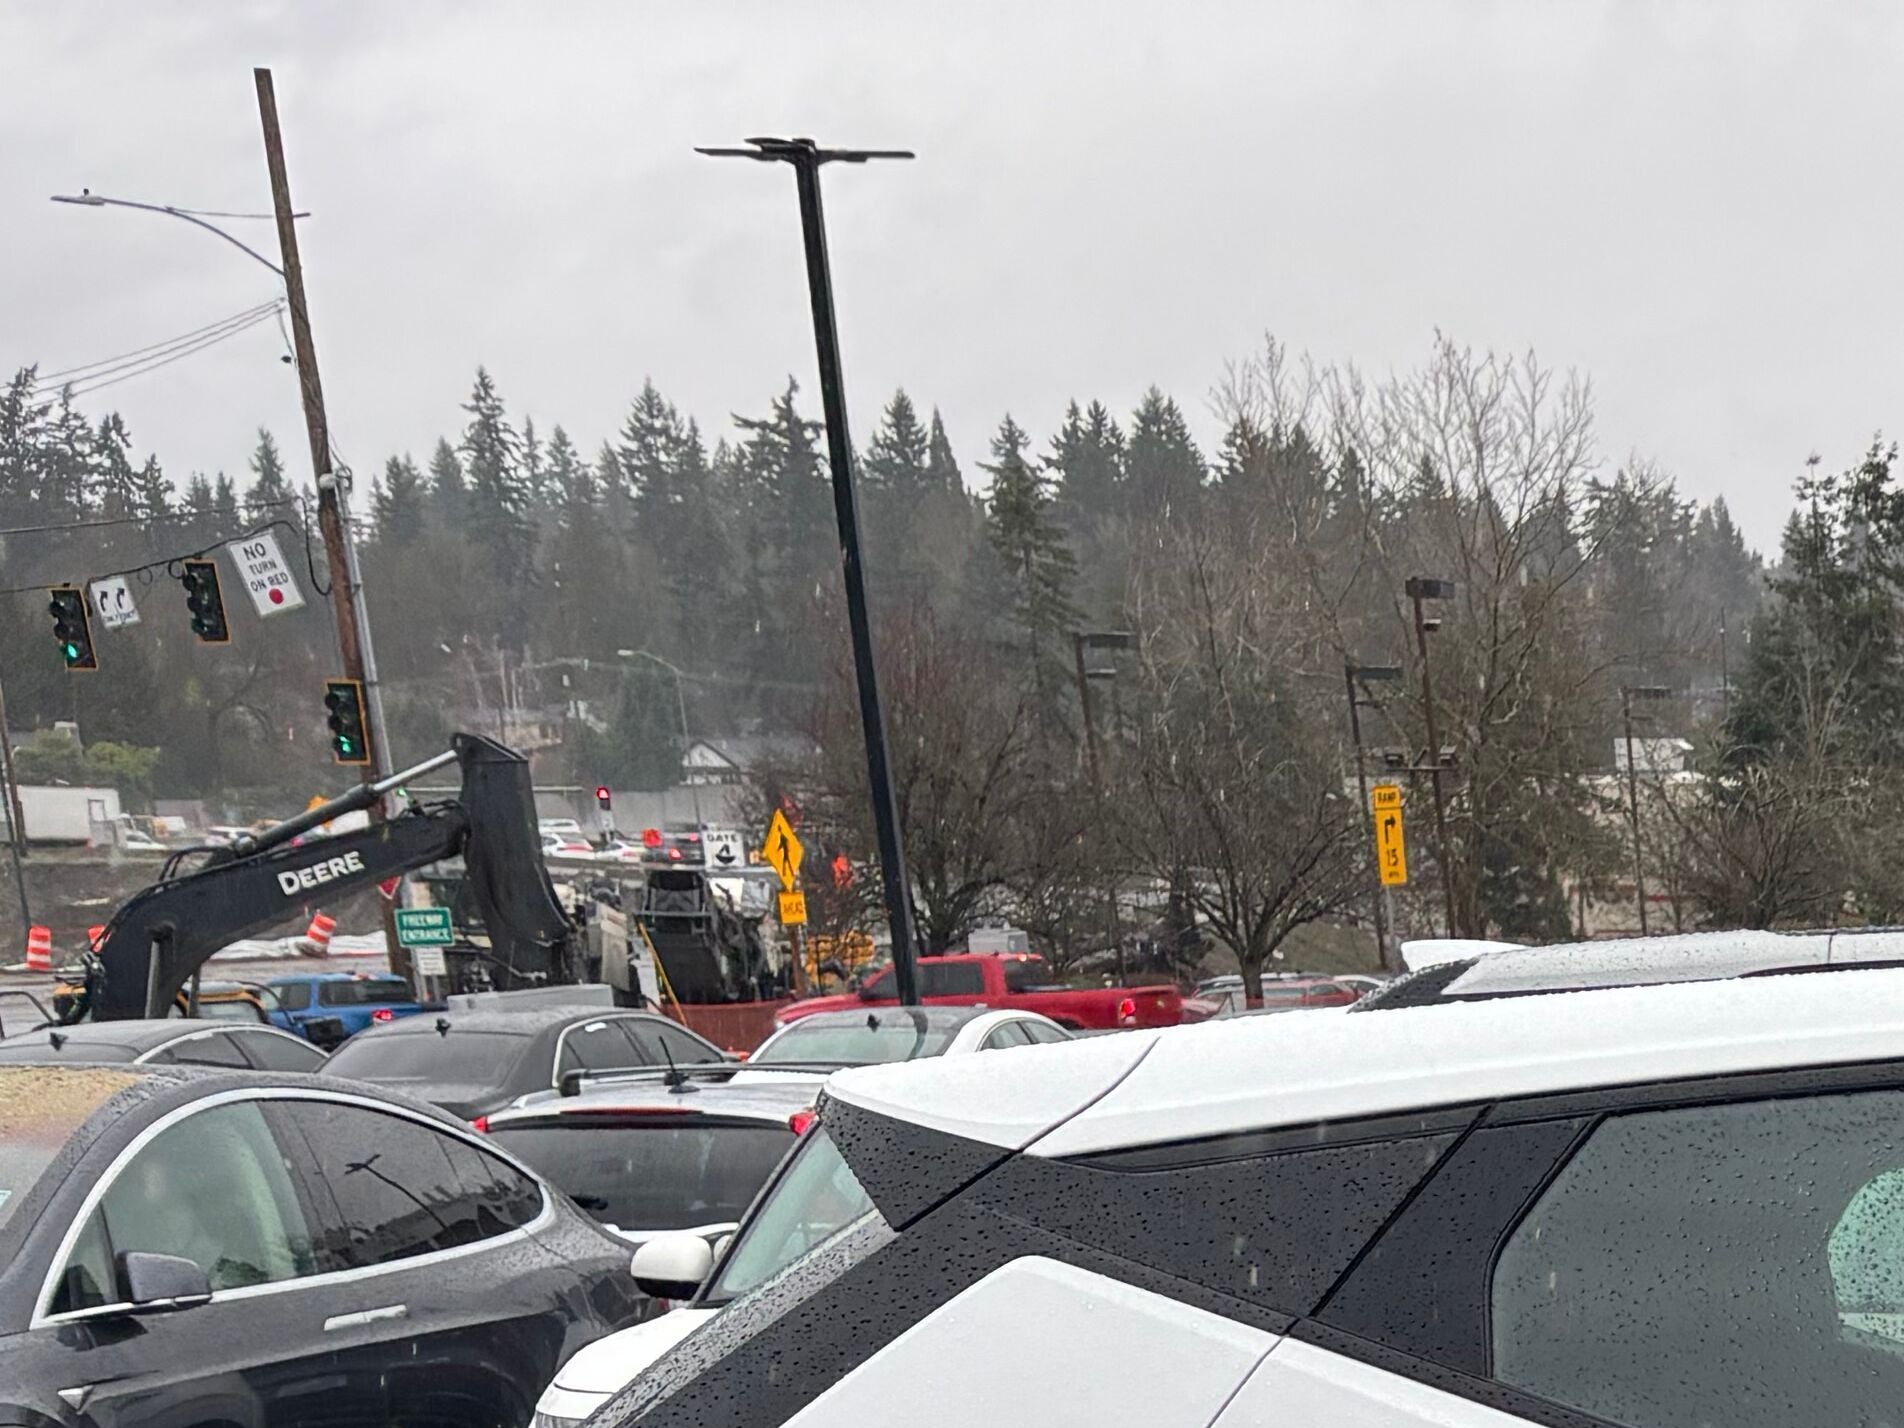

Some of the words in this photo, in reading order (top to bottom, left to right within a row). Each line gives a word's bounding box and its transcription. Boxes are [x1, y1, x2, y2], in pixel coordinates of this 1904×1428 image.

[243, 542, 266, 561] NO
[249, 559, 277, 575] TURN
[250, 579, 267, 592] ON
[267, 572, 289, 586] RED
[1387, 848, 1398, 867] 15
[278, 851, 365, 896] DEERE
